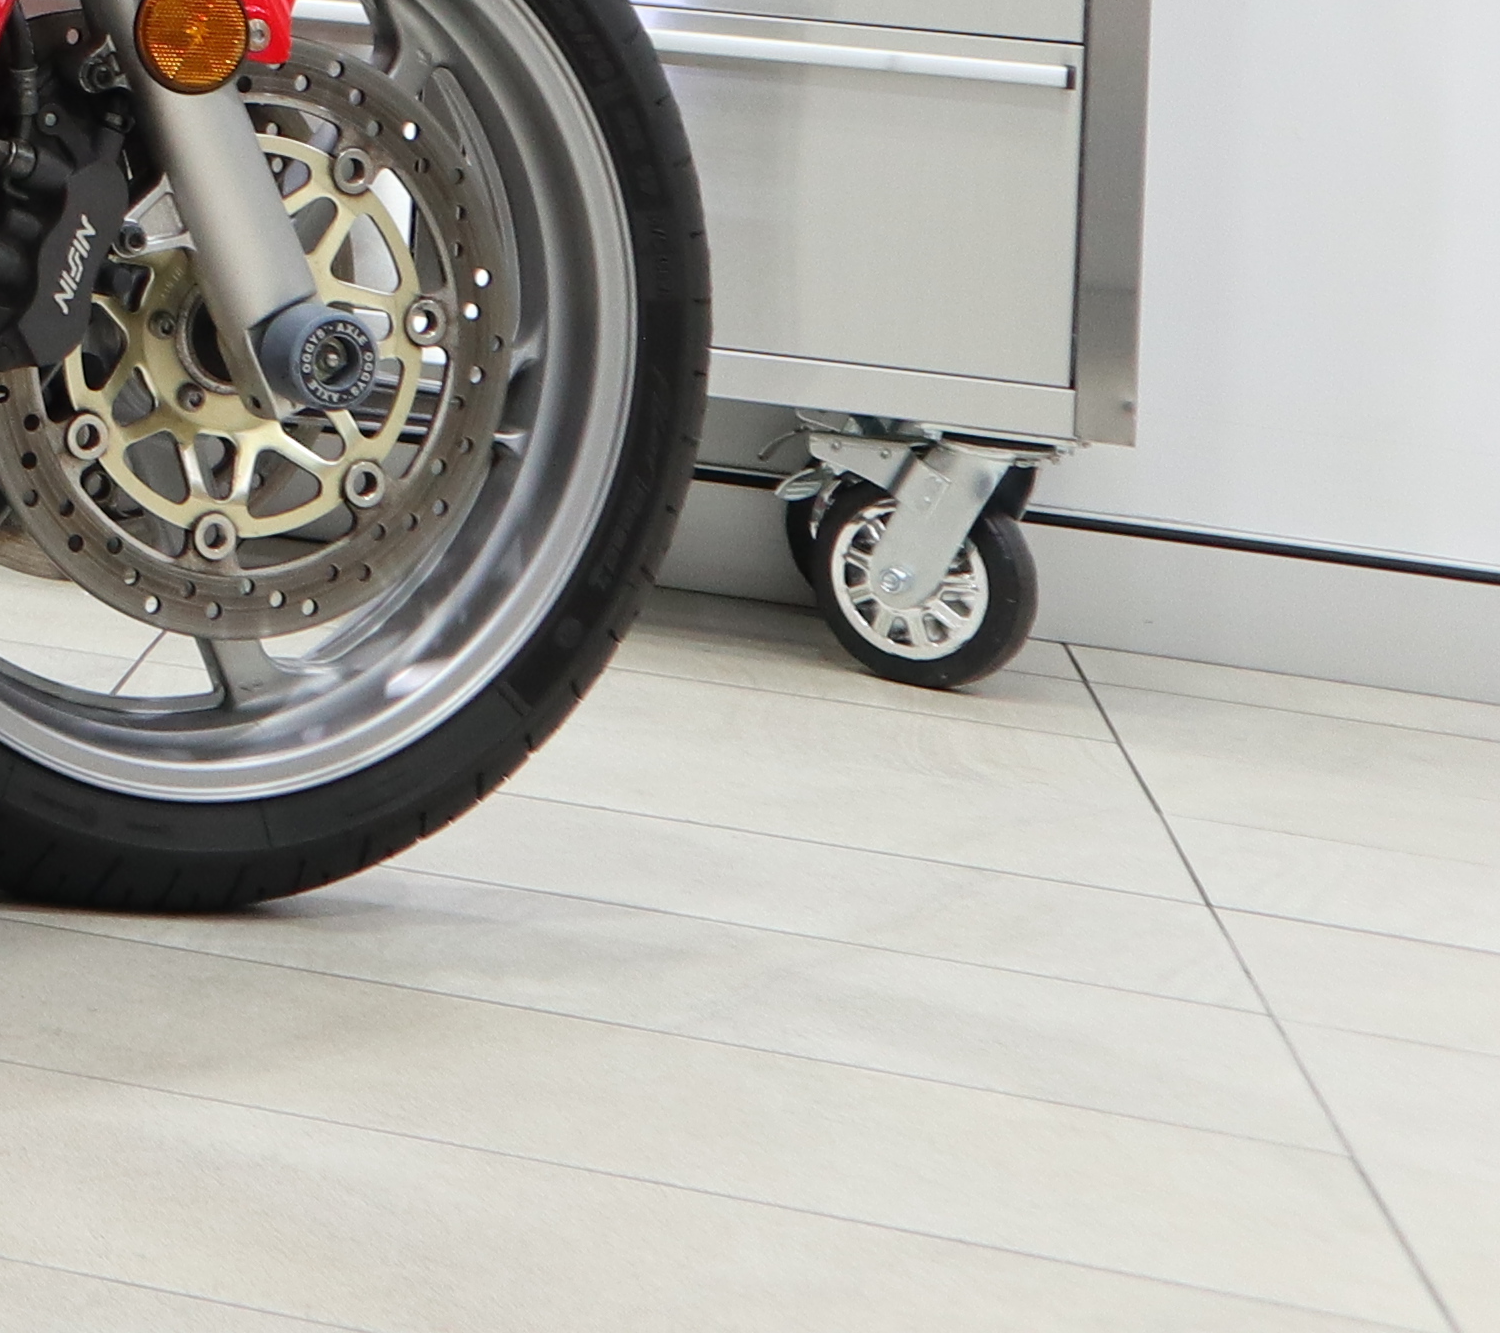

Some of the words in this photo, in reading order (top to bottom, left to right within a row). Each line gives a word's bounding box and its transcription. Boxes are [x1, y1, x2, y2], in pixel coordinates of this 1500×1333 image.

[51, 213, 97, 317] NISSIN
[335, 322, 368, 346] AXLE
[306, 379, 339, 402] AXLE
